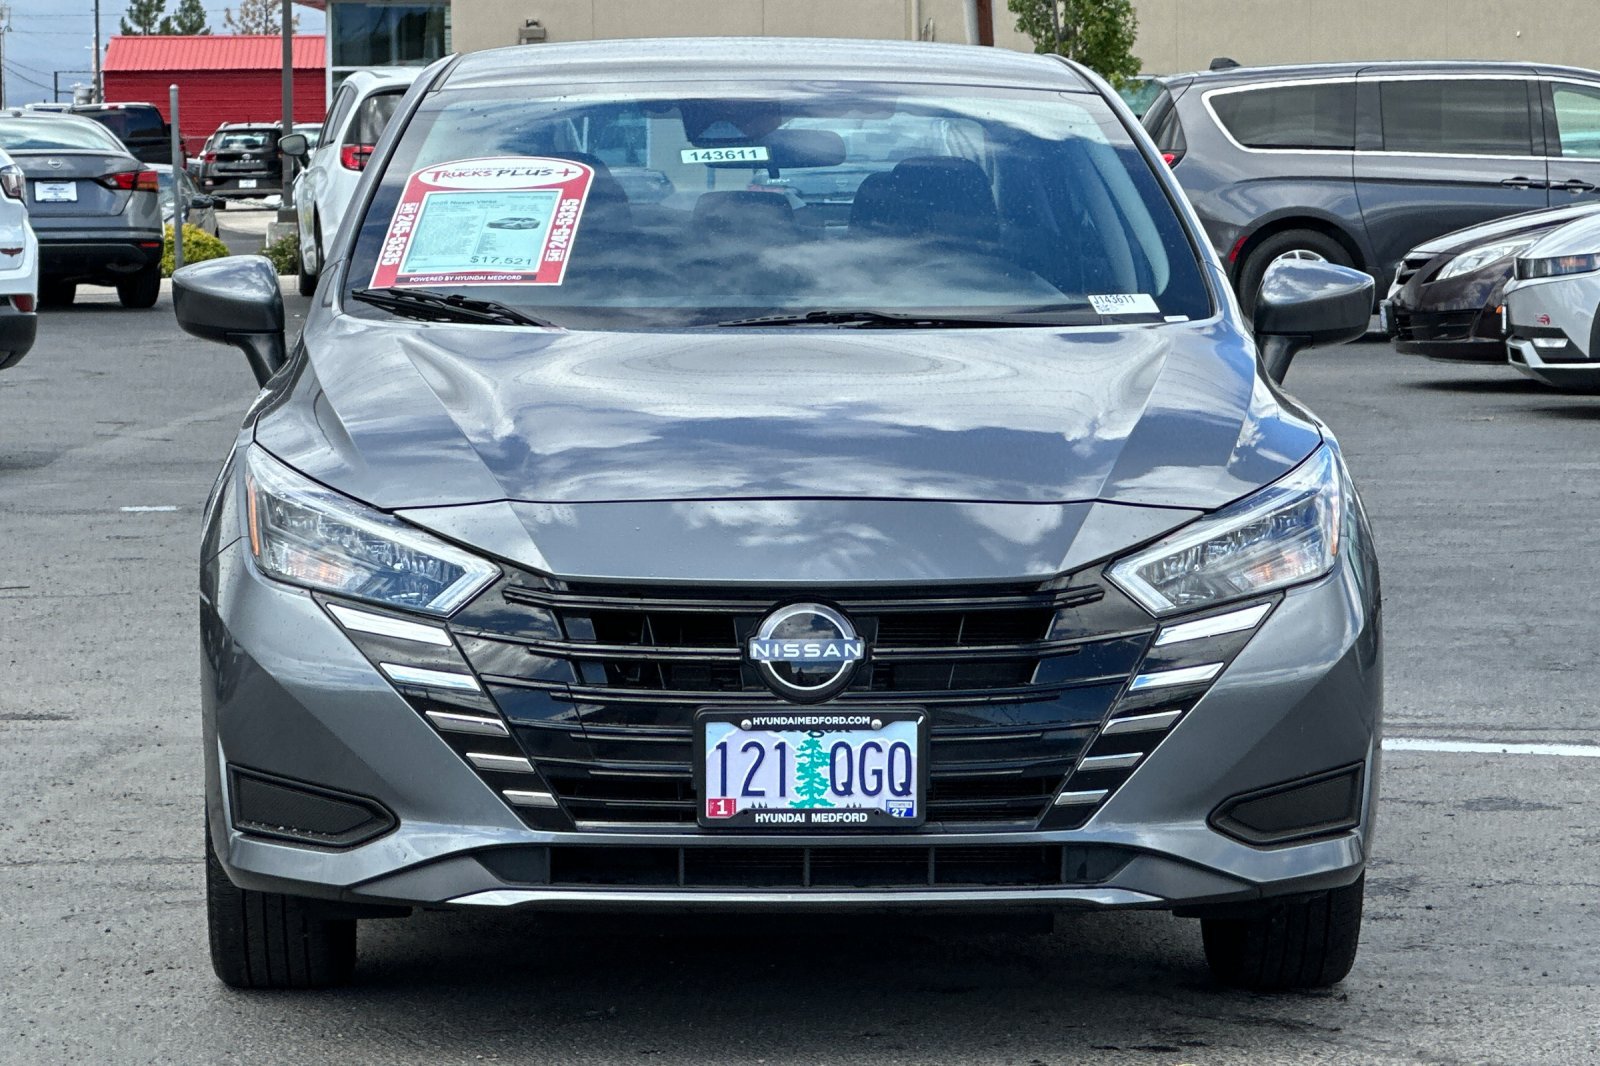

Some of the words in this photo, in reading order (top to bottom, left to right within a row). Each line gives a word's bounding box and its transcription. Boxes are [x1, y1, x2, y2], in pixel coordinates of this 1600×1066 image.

[690, 149, 757, 161] 143611
[549, 198, 580, 249] 245-5335
[1093, 295, 1135, 304] J143611
[753, 643, 860, 657] NISSAN
[752, 716, 871, 726] HYUNDAIMEDFORD.COM
[716, 741, 786, 797] 121
[829, 741, 912, 797] QGQ
[716, 800, 728, 814] 1
[891, 808, 907, 817] 27
[755, 813, 805, 823] HYUNDAI
[811, 813, 868, 823] MEDFORD
